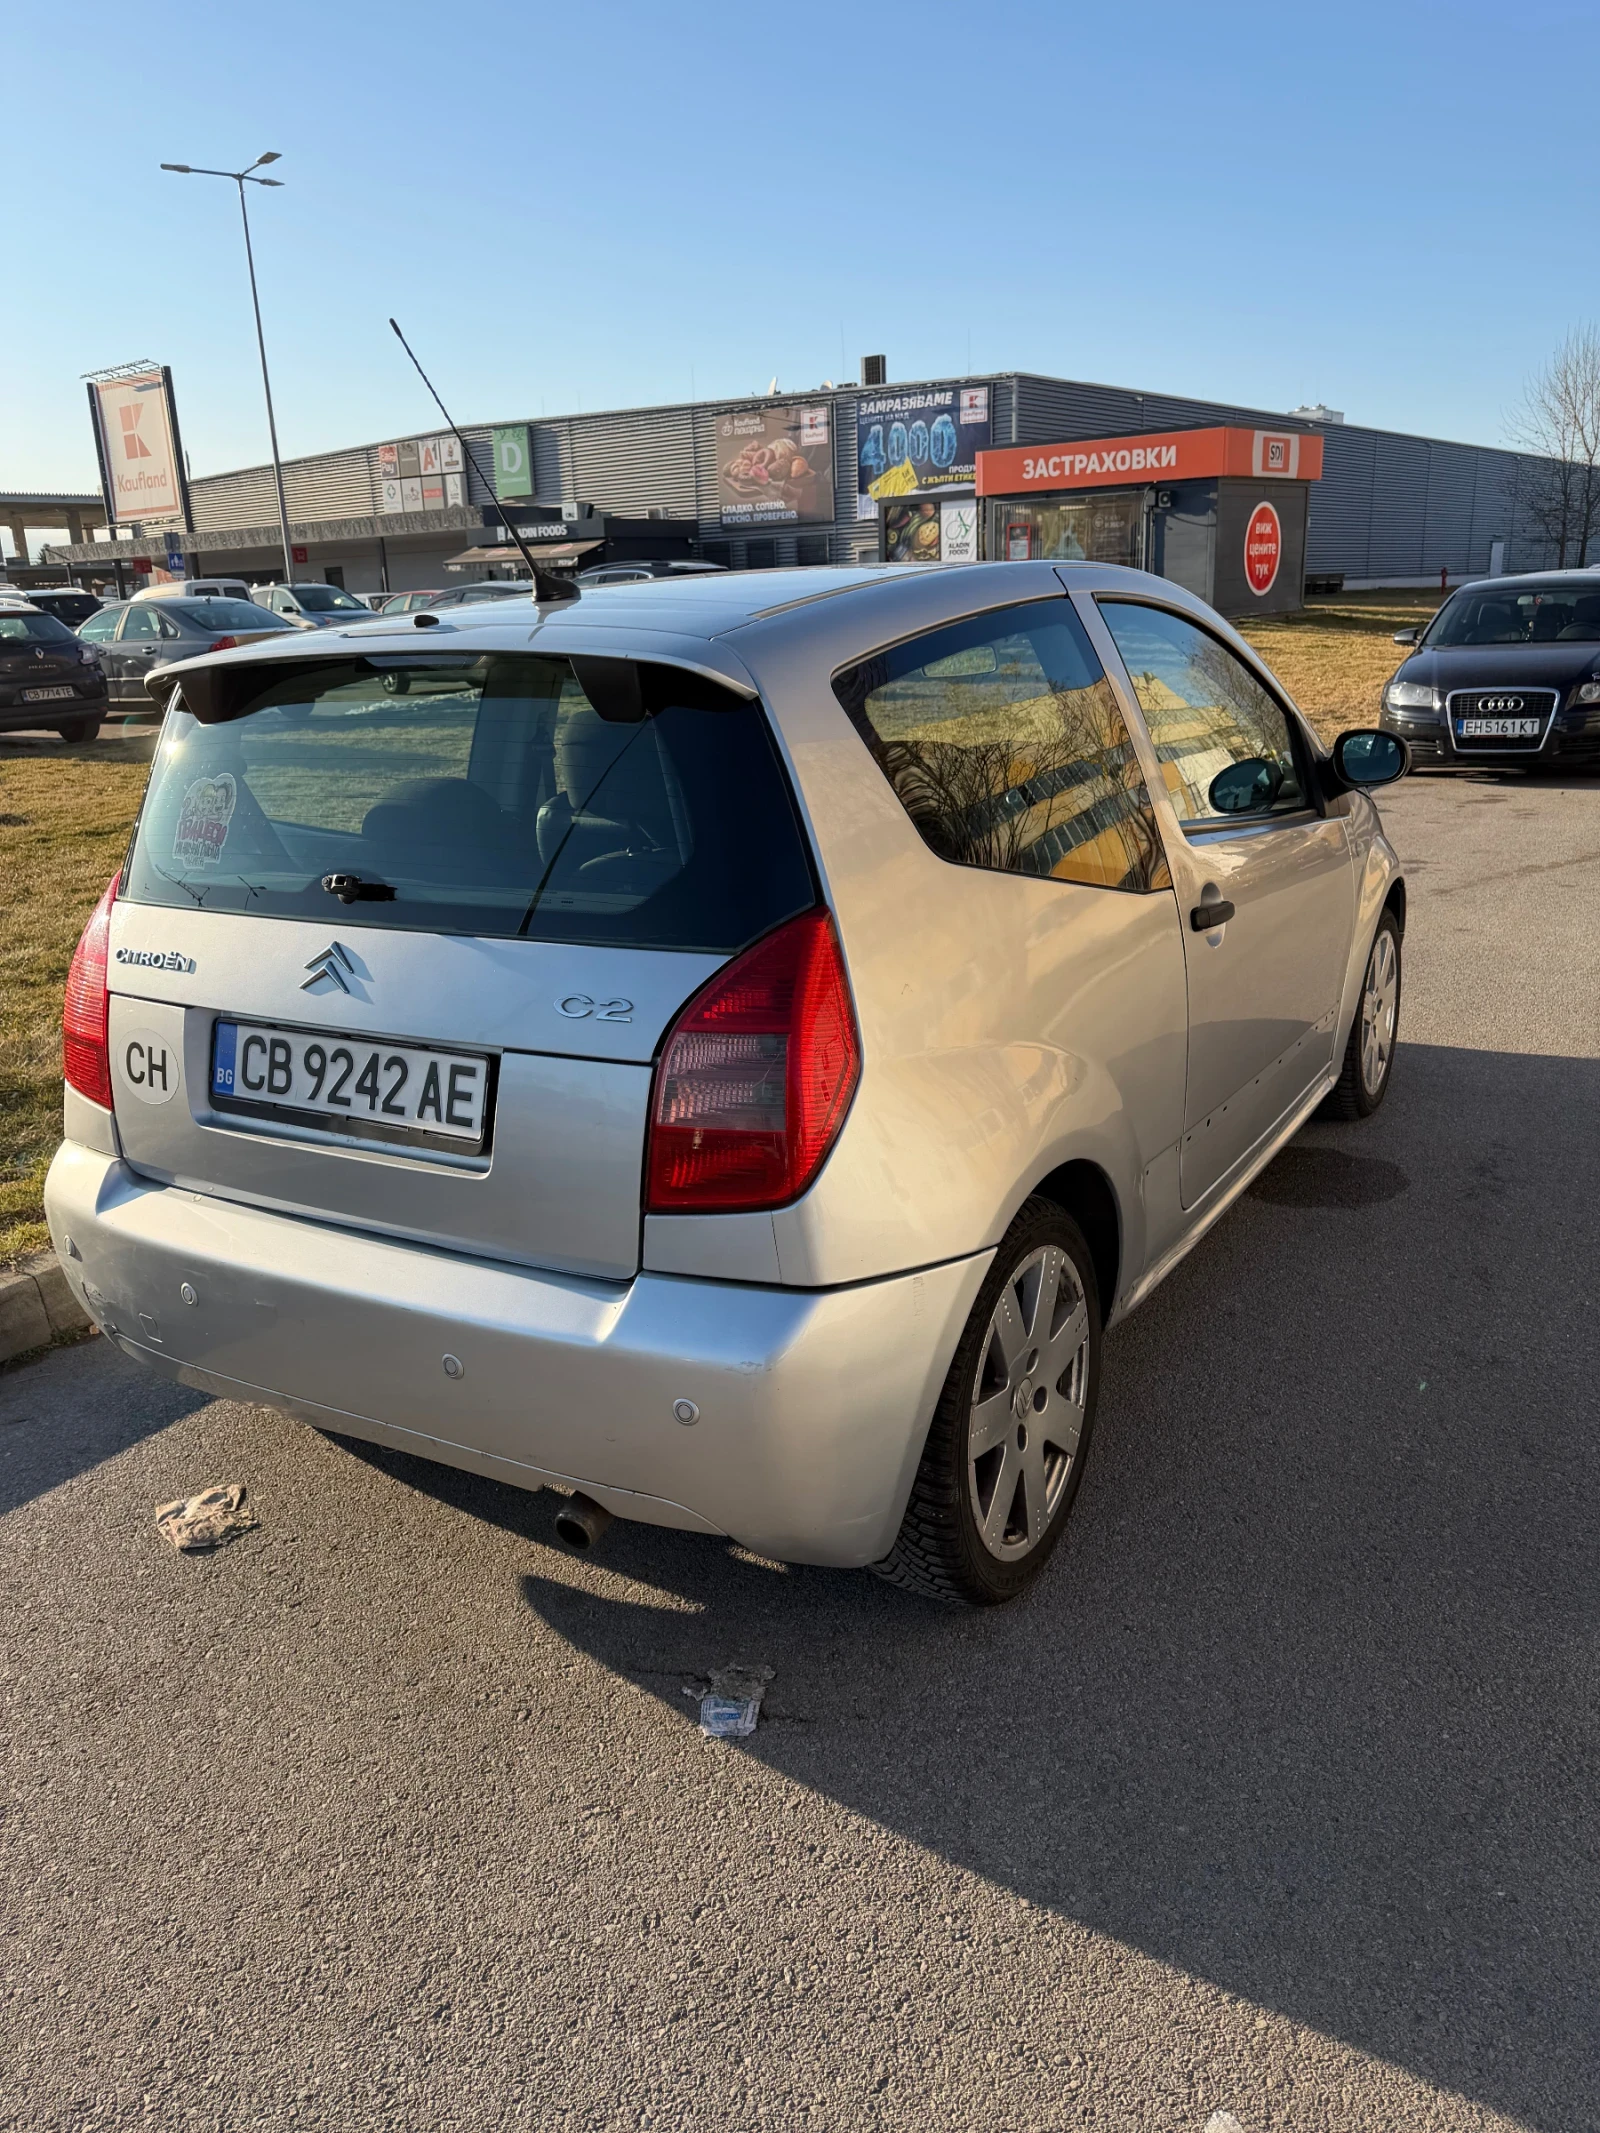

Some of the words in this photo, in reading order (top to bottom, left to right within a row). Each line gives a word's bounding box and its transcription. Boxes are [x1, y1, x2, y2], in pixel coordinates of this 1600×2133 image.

[860, 392, 954, 415] ЗАМРАЗЯВАМЕ
[860, 413, 957, 475] 4000
[1270, 444, 1284, 461] SDI
[1022, 445, 1177, 480] ЗАСТРАХОВКИ
[117, 468, 168, 493] Kaufland
[538, 524, 568, 537] FOODS
[115, 948, 194, 974] CITROËN
[553, 993, 635, 1023] C2
[126, 1041, 168, 1091] CH
[216, 1067, 233, 1085] BG
[241, 1035, 293, 1095] CB
[303, 1044, 409, 1116] 9242
[416, 1060, 477, 1127] AE
